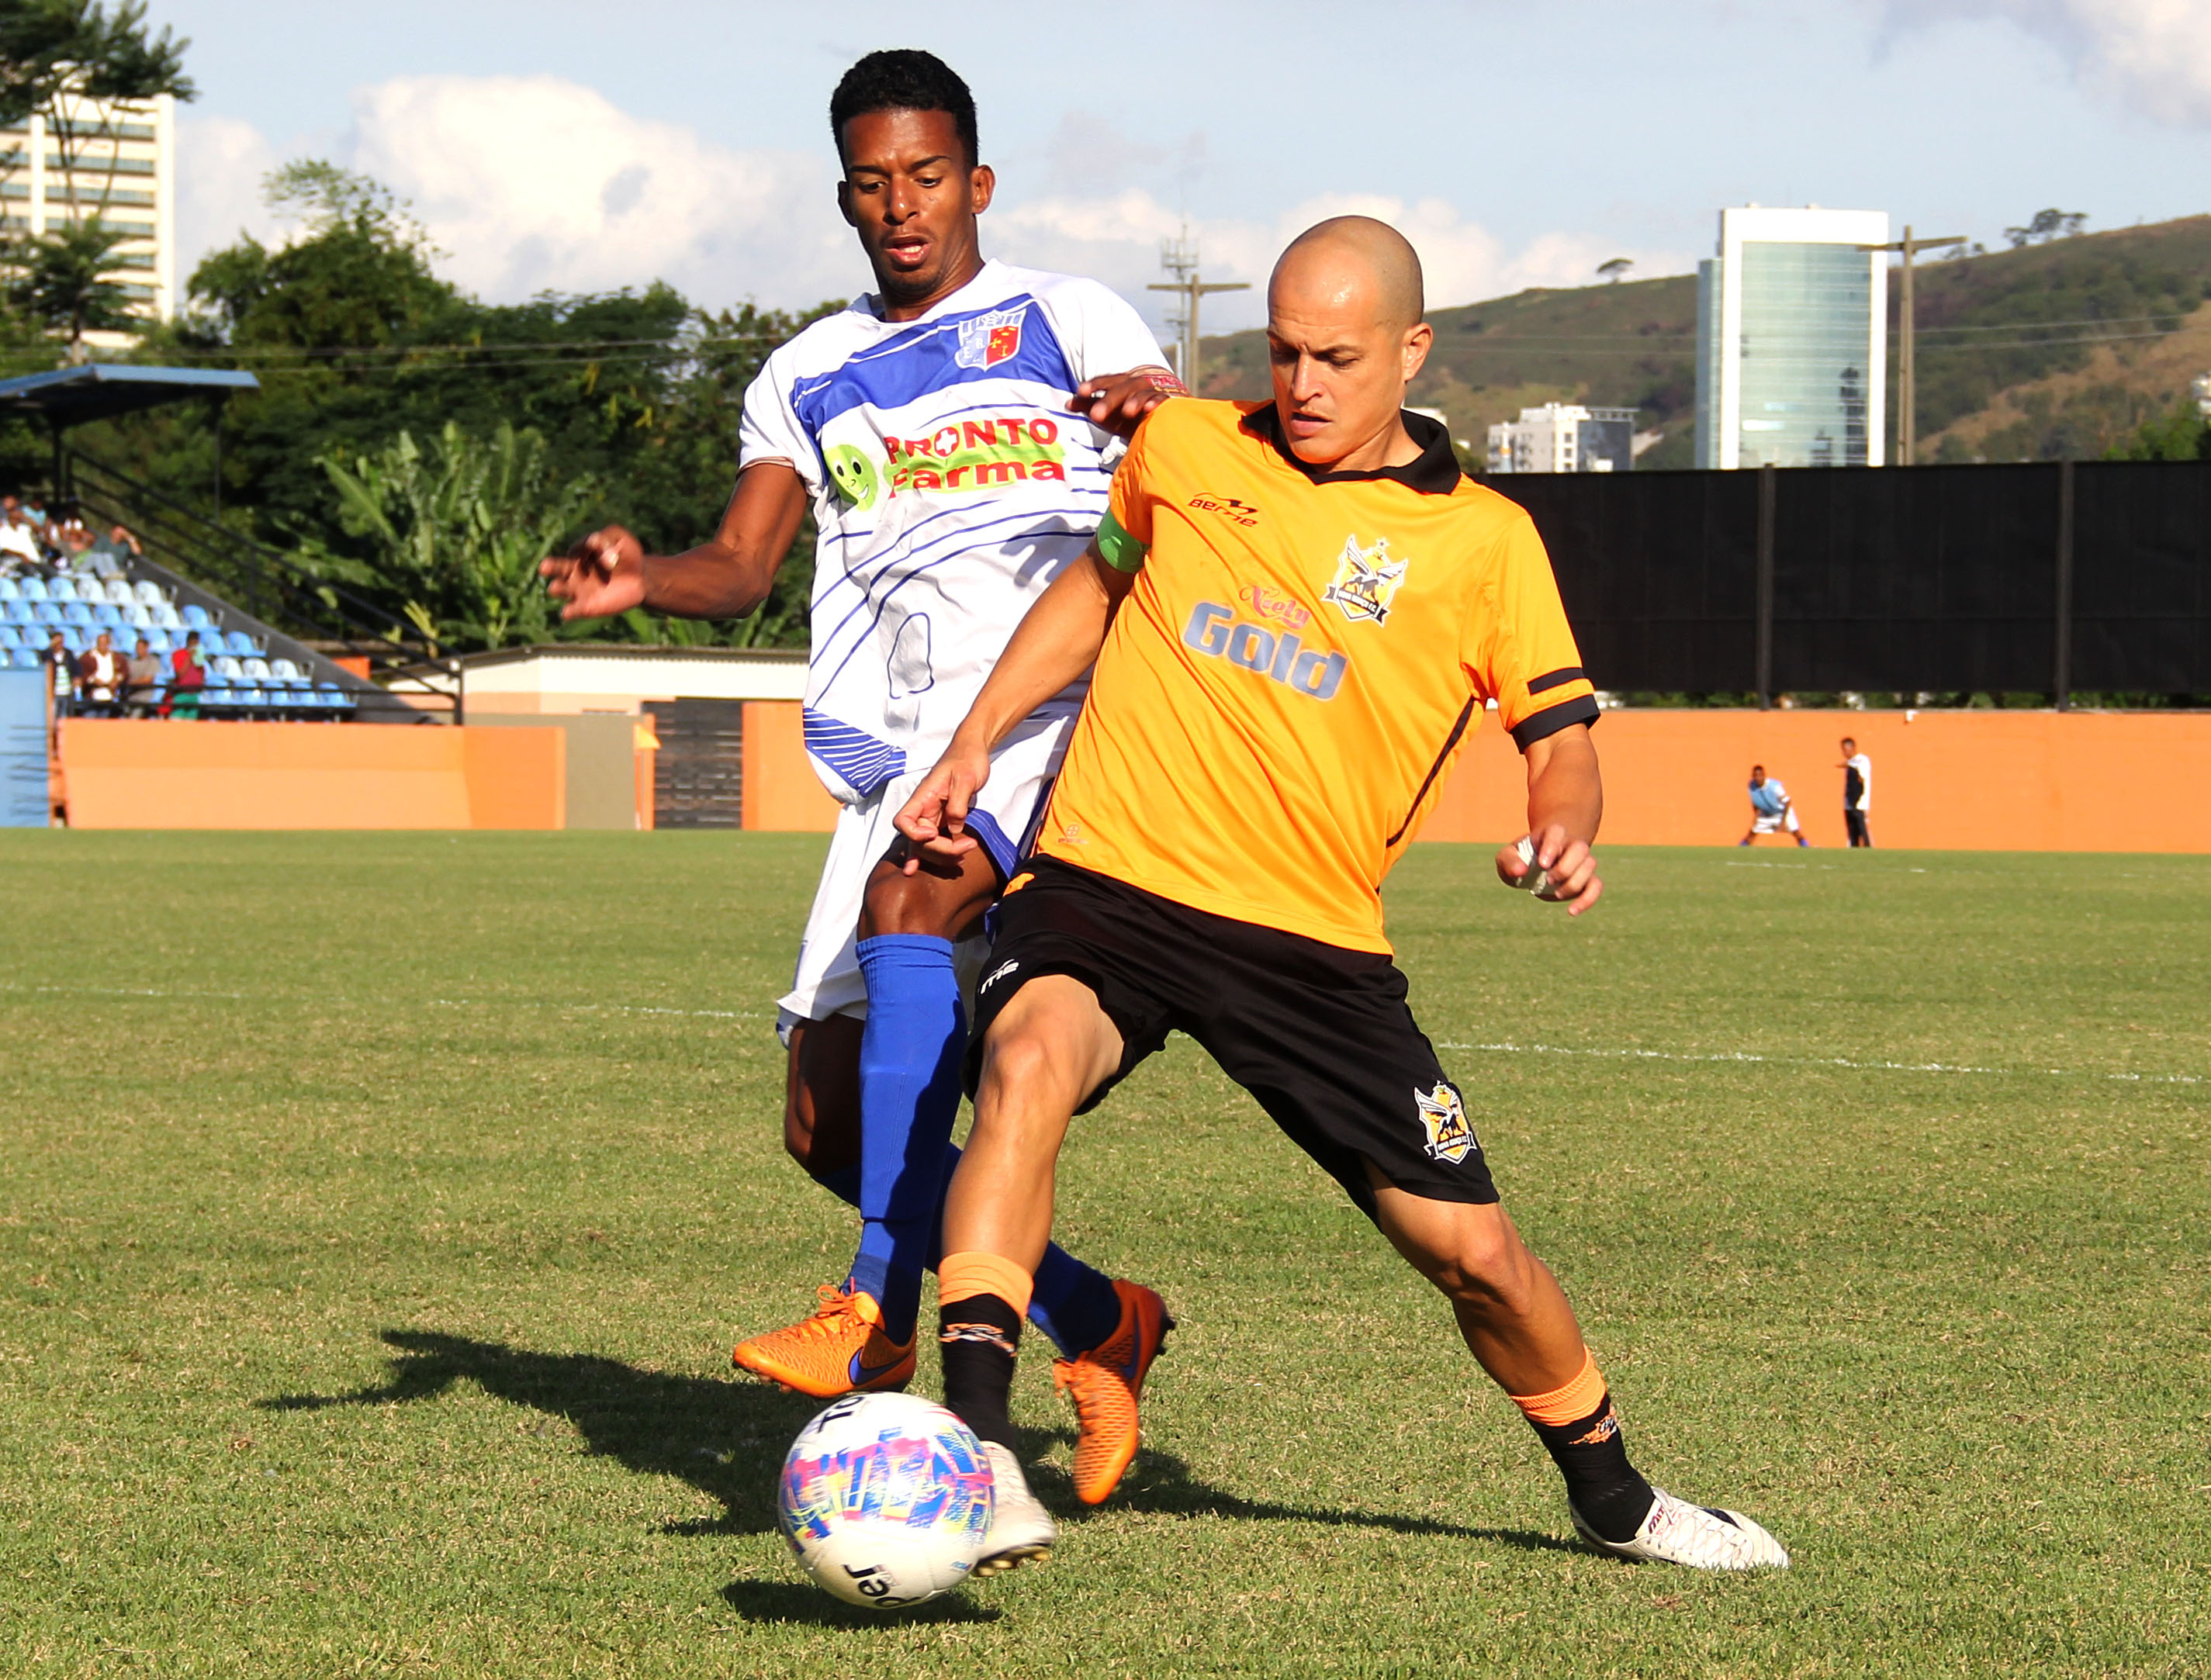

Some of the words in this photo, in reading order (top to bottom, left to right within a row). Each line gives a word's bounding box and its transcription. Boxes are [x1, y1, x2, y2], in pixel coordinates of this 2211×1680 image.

[884, 418, 1058, 465] PRONTO
[888, 459, 1065, 500] Farma
[1184, 602, 1348, 700] Gold
